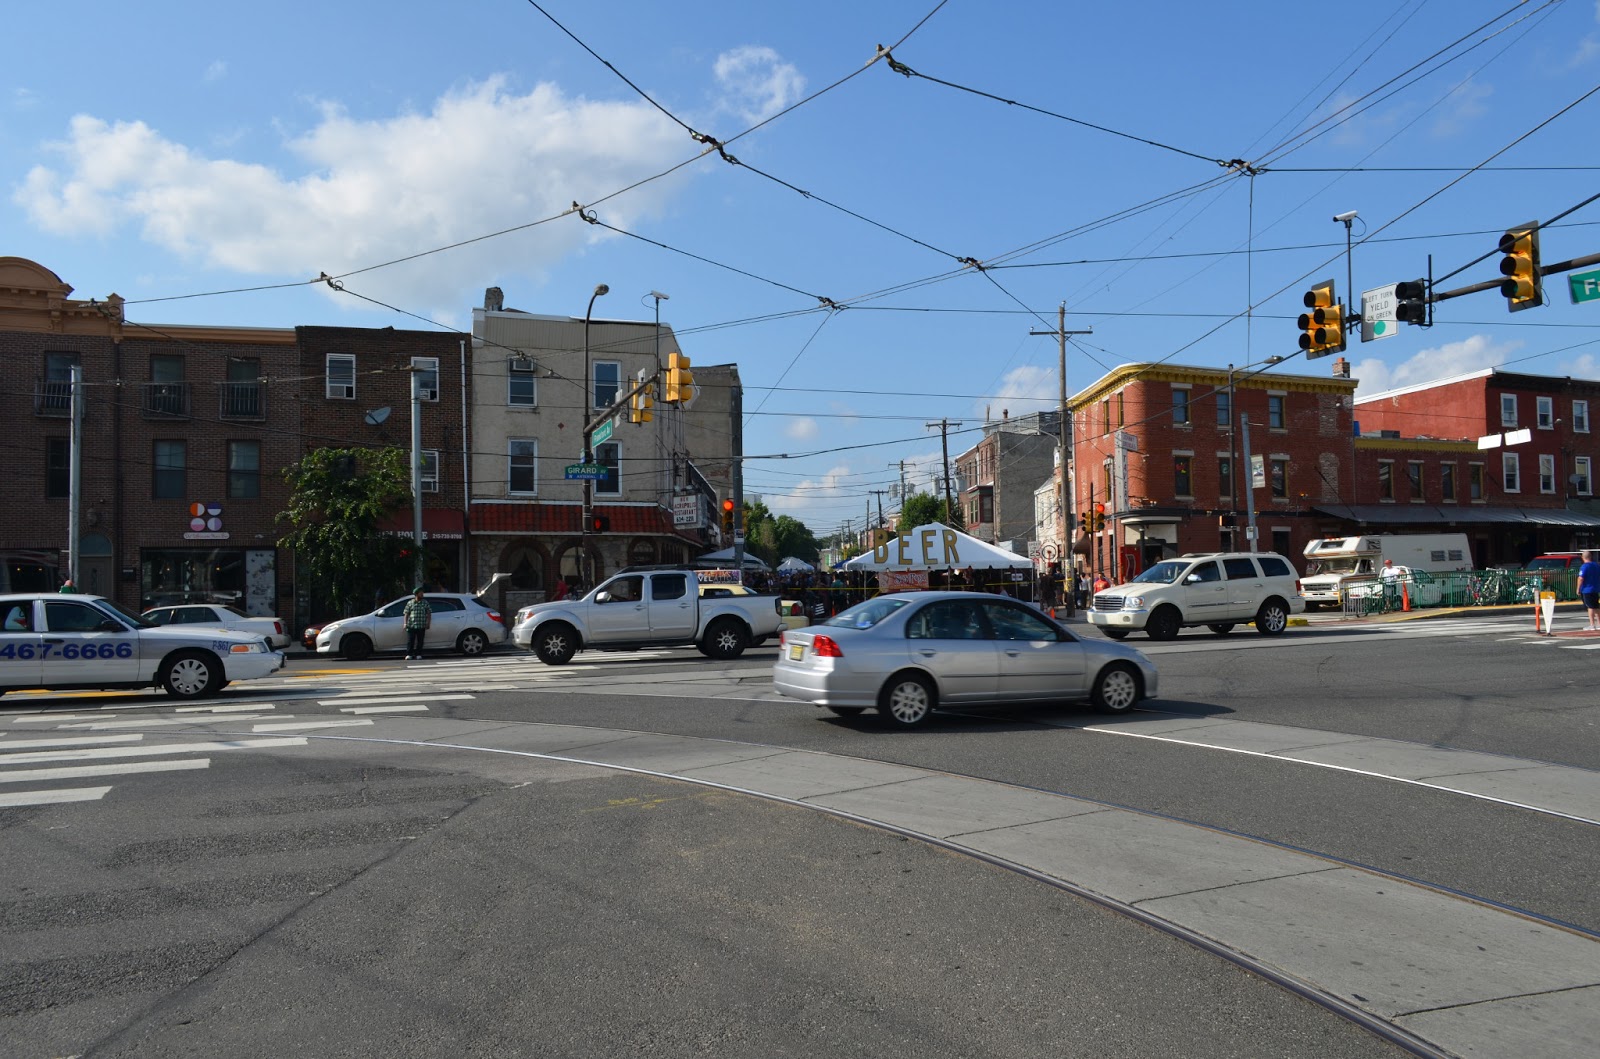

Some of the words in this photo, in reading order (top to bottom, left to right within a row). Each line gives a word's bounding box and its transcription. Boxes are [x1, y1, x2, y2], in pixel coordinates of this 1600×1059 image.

[1365, 294, 1378, 303] LEFT
[1380, 290, 1393, 299] TURN
[1370, 300, 1389, 312] YIELD
[1375, 310, 1392, 320] GREEN
[874, 529, 960, 566] BEER
[0, 642, 133, 660] 467-6666
